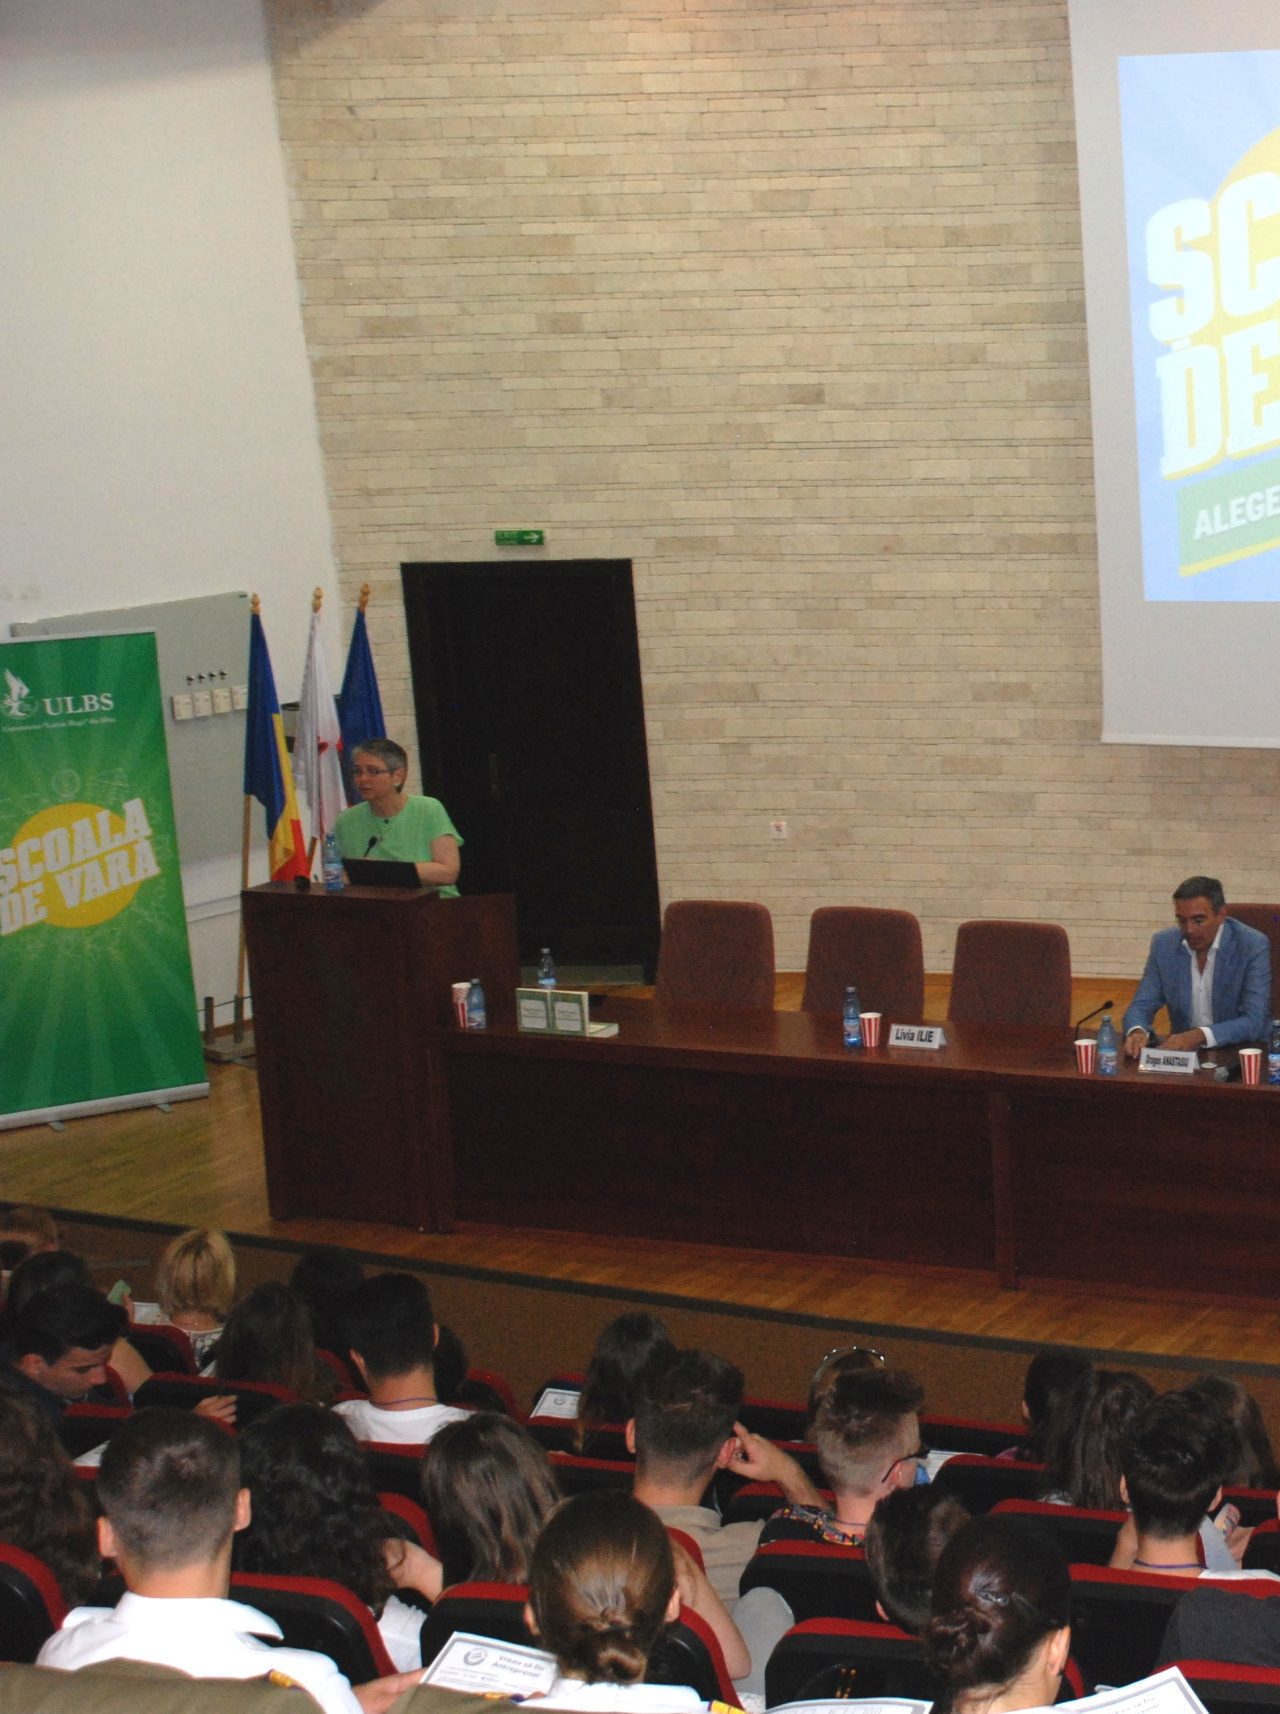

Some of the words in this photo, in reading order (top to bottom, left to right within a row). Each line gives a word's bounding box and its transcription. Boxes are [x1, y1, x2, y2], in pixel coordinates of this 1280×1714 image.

[42, 693, 114, 716] ULBS
[0, 881, 49, 936] DE
[895, 1028, 915, 1042] Livia
[917, 1030, 934, 1043] ILIE
